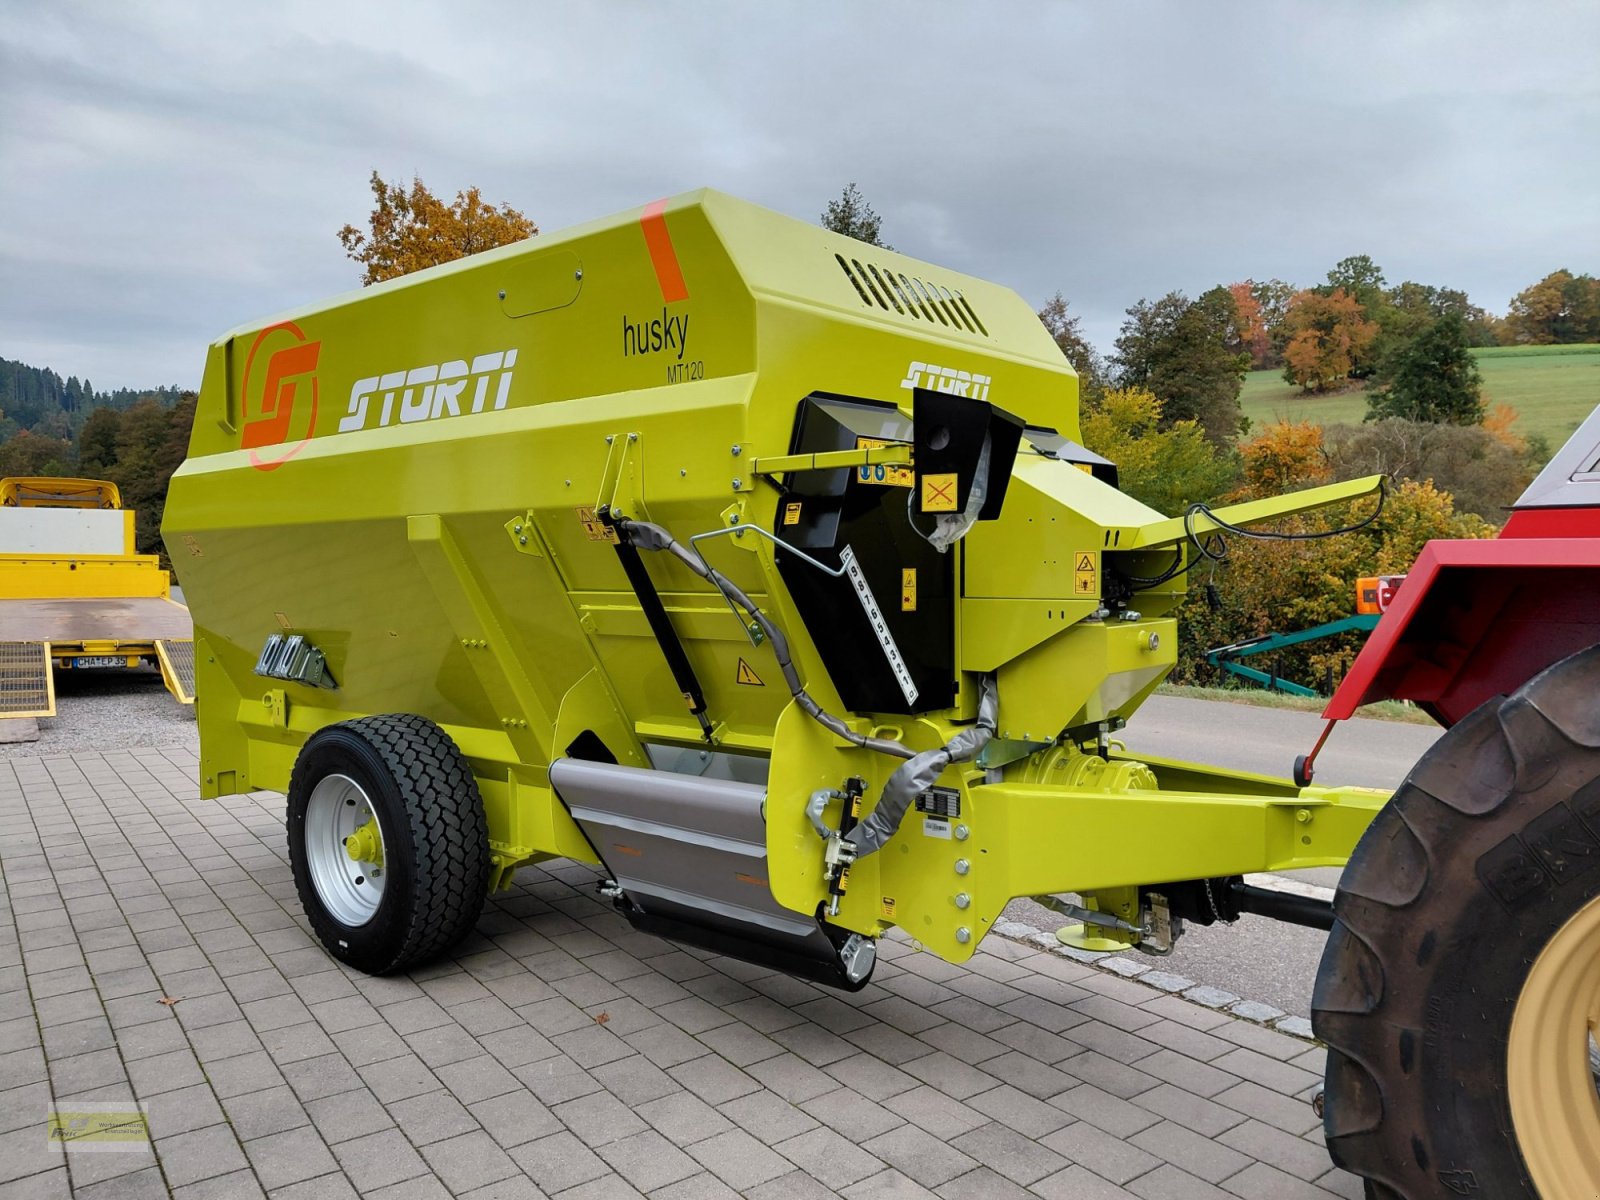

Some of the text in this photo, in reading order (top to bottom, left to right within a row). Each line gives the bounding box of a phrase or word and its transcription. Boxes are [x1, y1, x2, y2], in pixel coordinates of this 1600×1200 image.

[623, 306, 689, 360] husky
[667, 360, 704, 384] MT120
[338, 348, 518, 433] STORTI
[850, 565, 858, 578] 9
[857, 580, 865, 591] 8
[864, 593, 871, 605] 7
[870, 608, 878, 620] 6
[877, 622, 884, 633] 5
[884, 635, 891, 646] 4
[890, 649, 897, 660] 3
[79, 657, 96, 666] CHA
[896, 663, 903, 674] 2
[902, 675, 909, 685] 1
